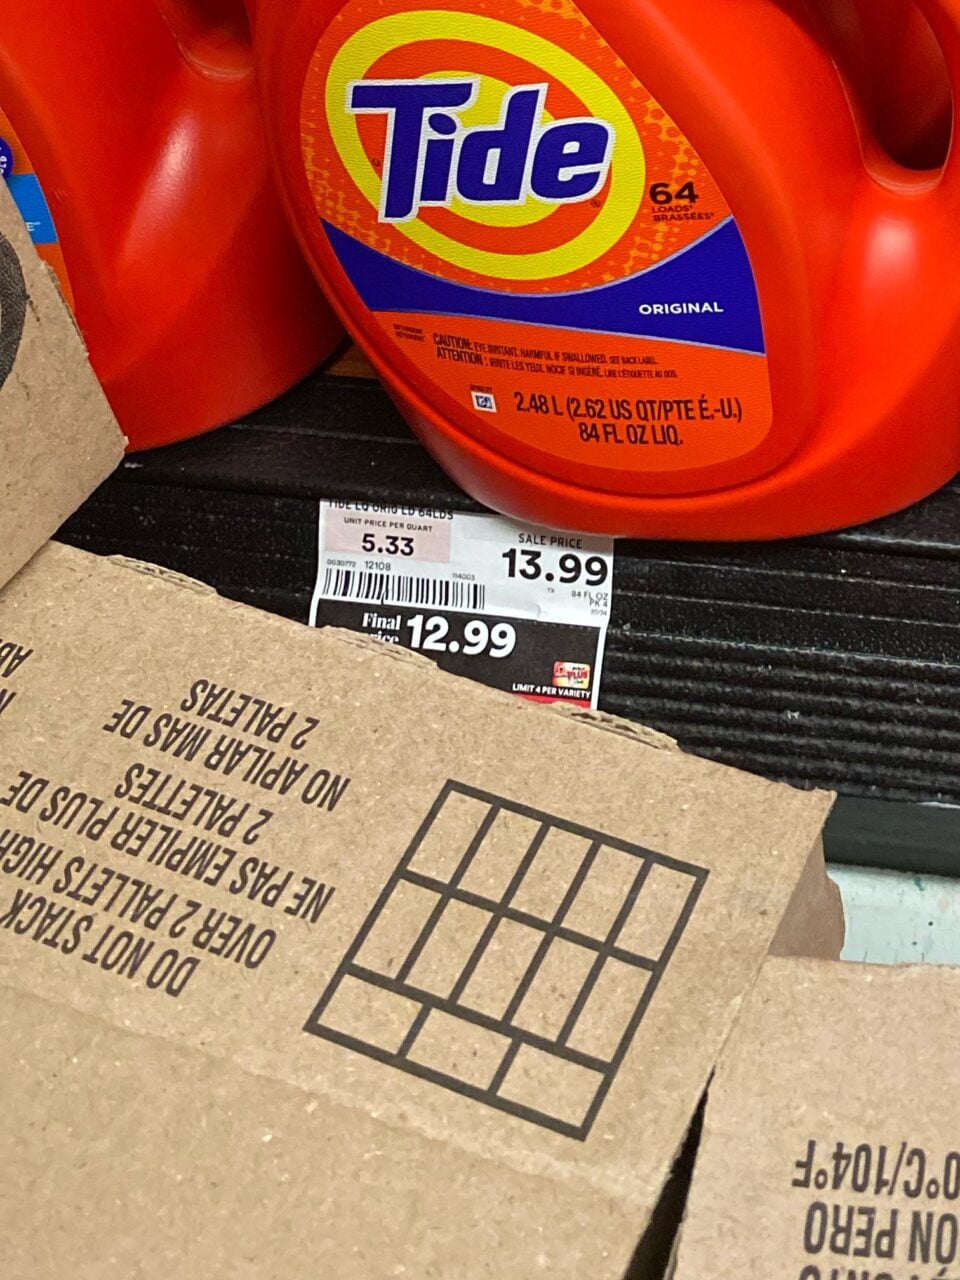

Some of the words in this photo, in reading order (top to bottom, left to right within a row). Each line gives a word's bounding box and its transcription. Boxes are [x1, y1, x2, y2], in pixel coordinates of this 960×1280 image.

[347, 77, 614, 222] Tide
[649, 181, 699, 205] 64
[638, 301, 724, 315] ORIGINAL
[513, 391, 550, 415] 2.48
[553, 395, 564, 416] L
[566, 395, 606, 422] (2.62
[609, 398, 633, 420] US
[635, 399, 694, 422] QT/PTE
[699, 393, 743, 424] É.-U.)
[579, 422, 600, 443] 84
[603, 423, 624, 444] FL
[626, 423, 650, 445] OZ
[652, 424, 684, 446] LIQ.
[344, 517, 362, 525] UNIT
[364, 519, 387, 528] PRICE
[389, 521, 404, 530] PER
[406, 523, 433, 533] QUART
[361, 533, 415, 556] 5.33
[518, 533, 546, 546] SALE
[549, 536, 583, 549] PRICE
[364, 560, 392, 572] 12108
[502, 548, 609, 586] 13.99
[362, 612, 401, 630] Final
[406, 613, 517, 659] 12.99
[180, 678, 298, 744] PALETAS
[512, 682, 535, 692] LIMIT
[535, 685, 541, 694] 4
[541, 686, 557, 696] PER
[558, 688, 592, 699] VARIETY
[102, 698, 153, 739] DE
[143, 713, 213, 762] MAS
[290, 716, 321, 751] 2
[203, 734, 310, 796] APILAR
[0, 770, 50, 814] DE
[114, 762, 252, 838] PALETTES
[300, 769, 352, 812] NO
[38, 786, 120, 842] PLUS
[242, 808, 275, 846] 2
[110, 811, 238, 887] EMPILER
[53, 856, 179, 932] PALLETS
[230, 856, 294, 908] PAS
[284, 876, 336, 924] NE
[0, 888, 94, 955] STACK
[168, 899, 203, 939] 2
[192, 908, 278, 969] OVER
[82, 925, 156, 979] NOT
[146, 948, 201, 997] DO
[802, 1200, 900, 1260] PERO
